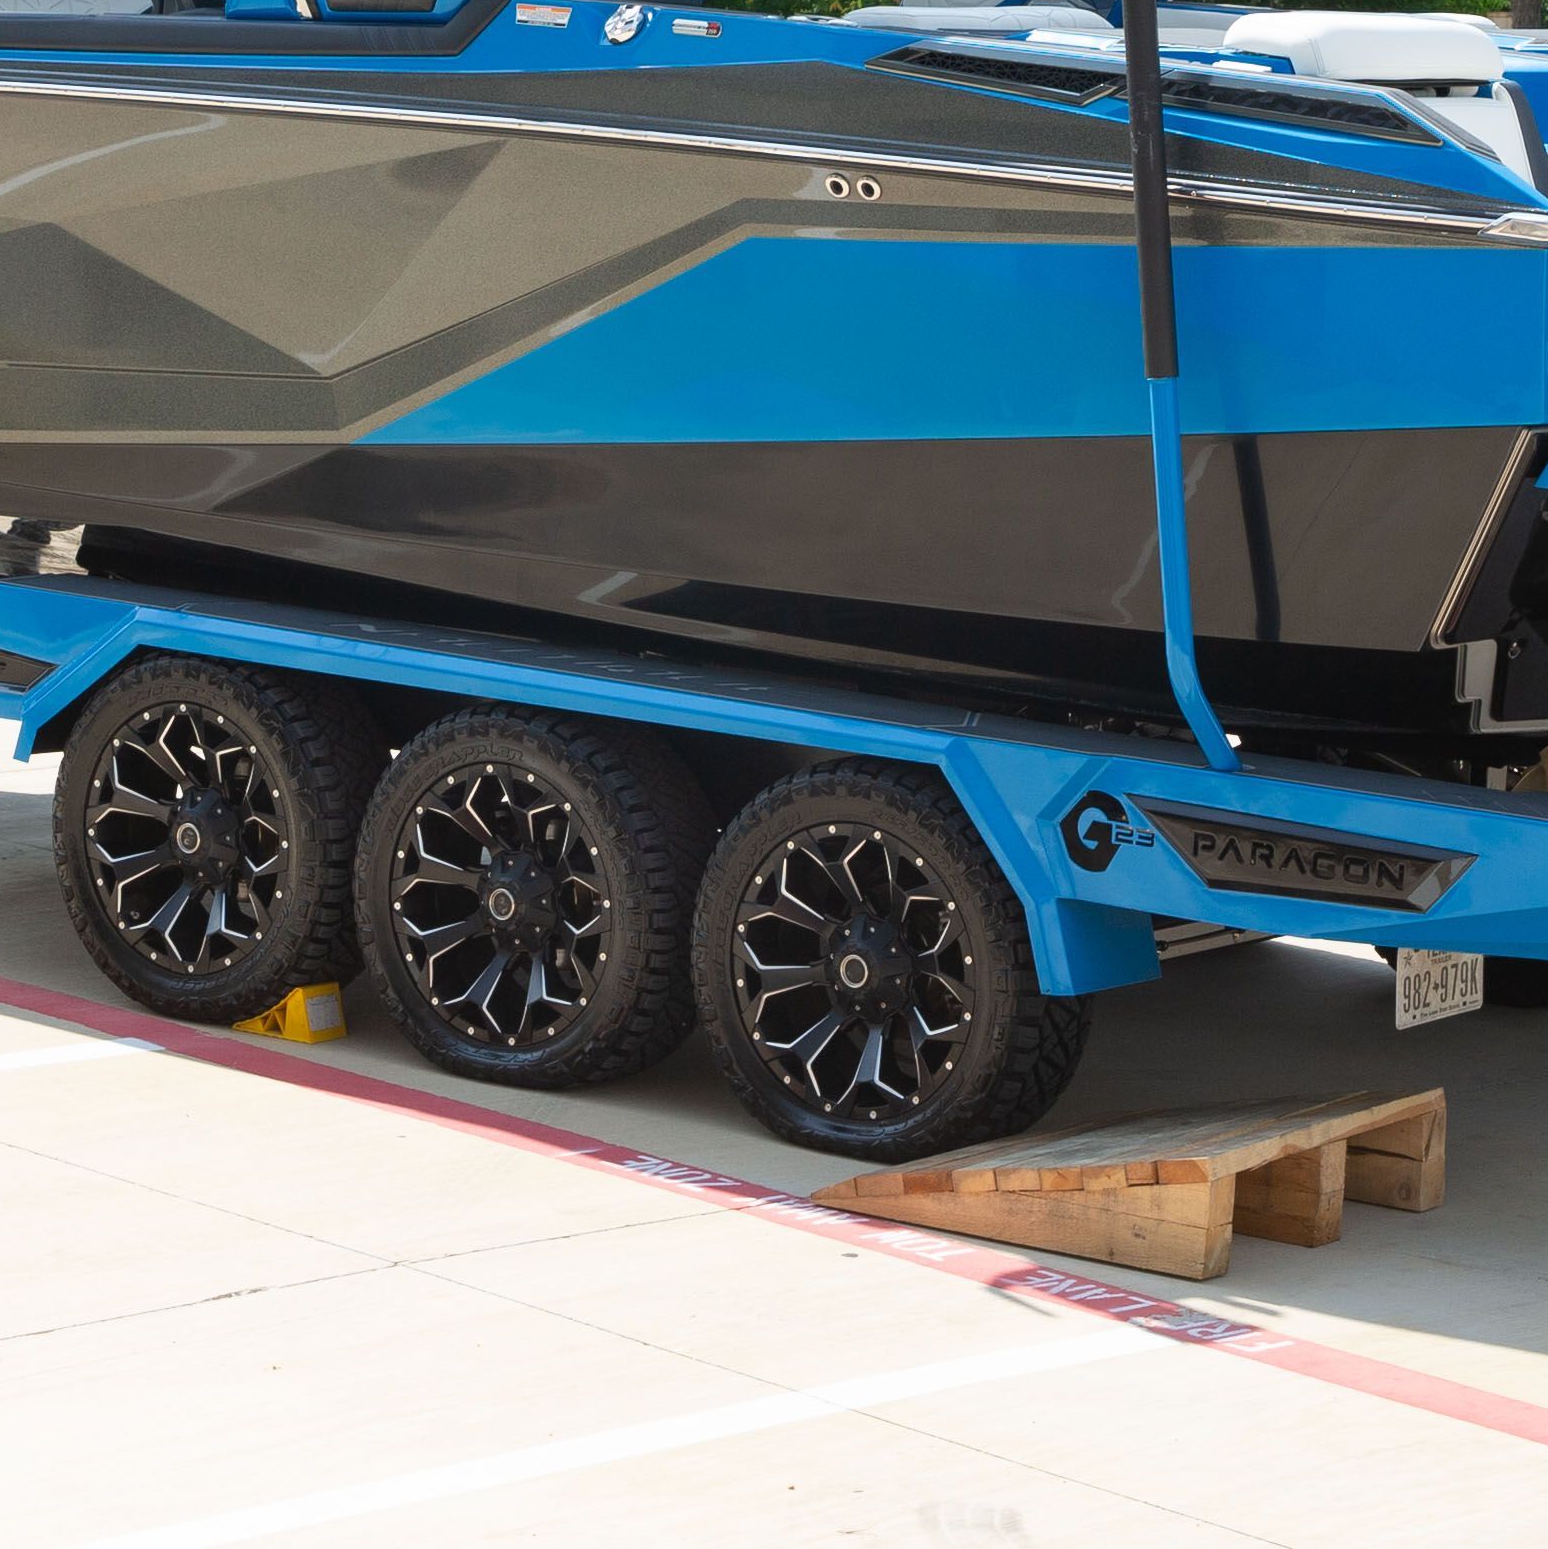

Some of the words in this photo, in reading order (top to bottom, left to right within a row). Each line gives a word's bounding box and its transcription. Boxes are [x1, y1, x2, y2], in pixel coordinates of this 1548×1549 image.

[1191, 830, 1406, 891] PARAGON
[859, 1229, 976, 1261] TOW
[1000, 1270, 1158, 1313] LANE
